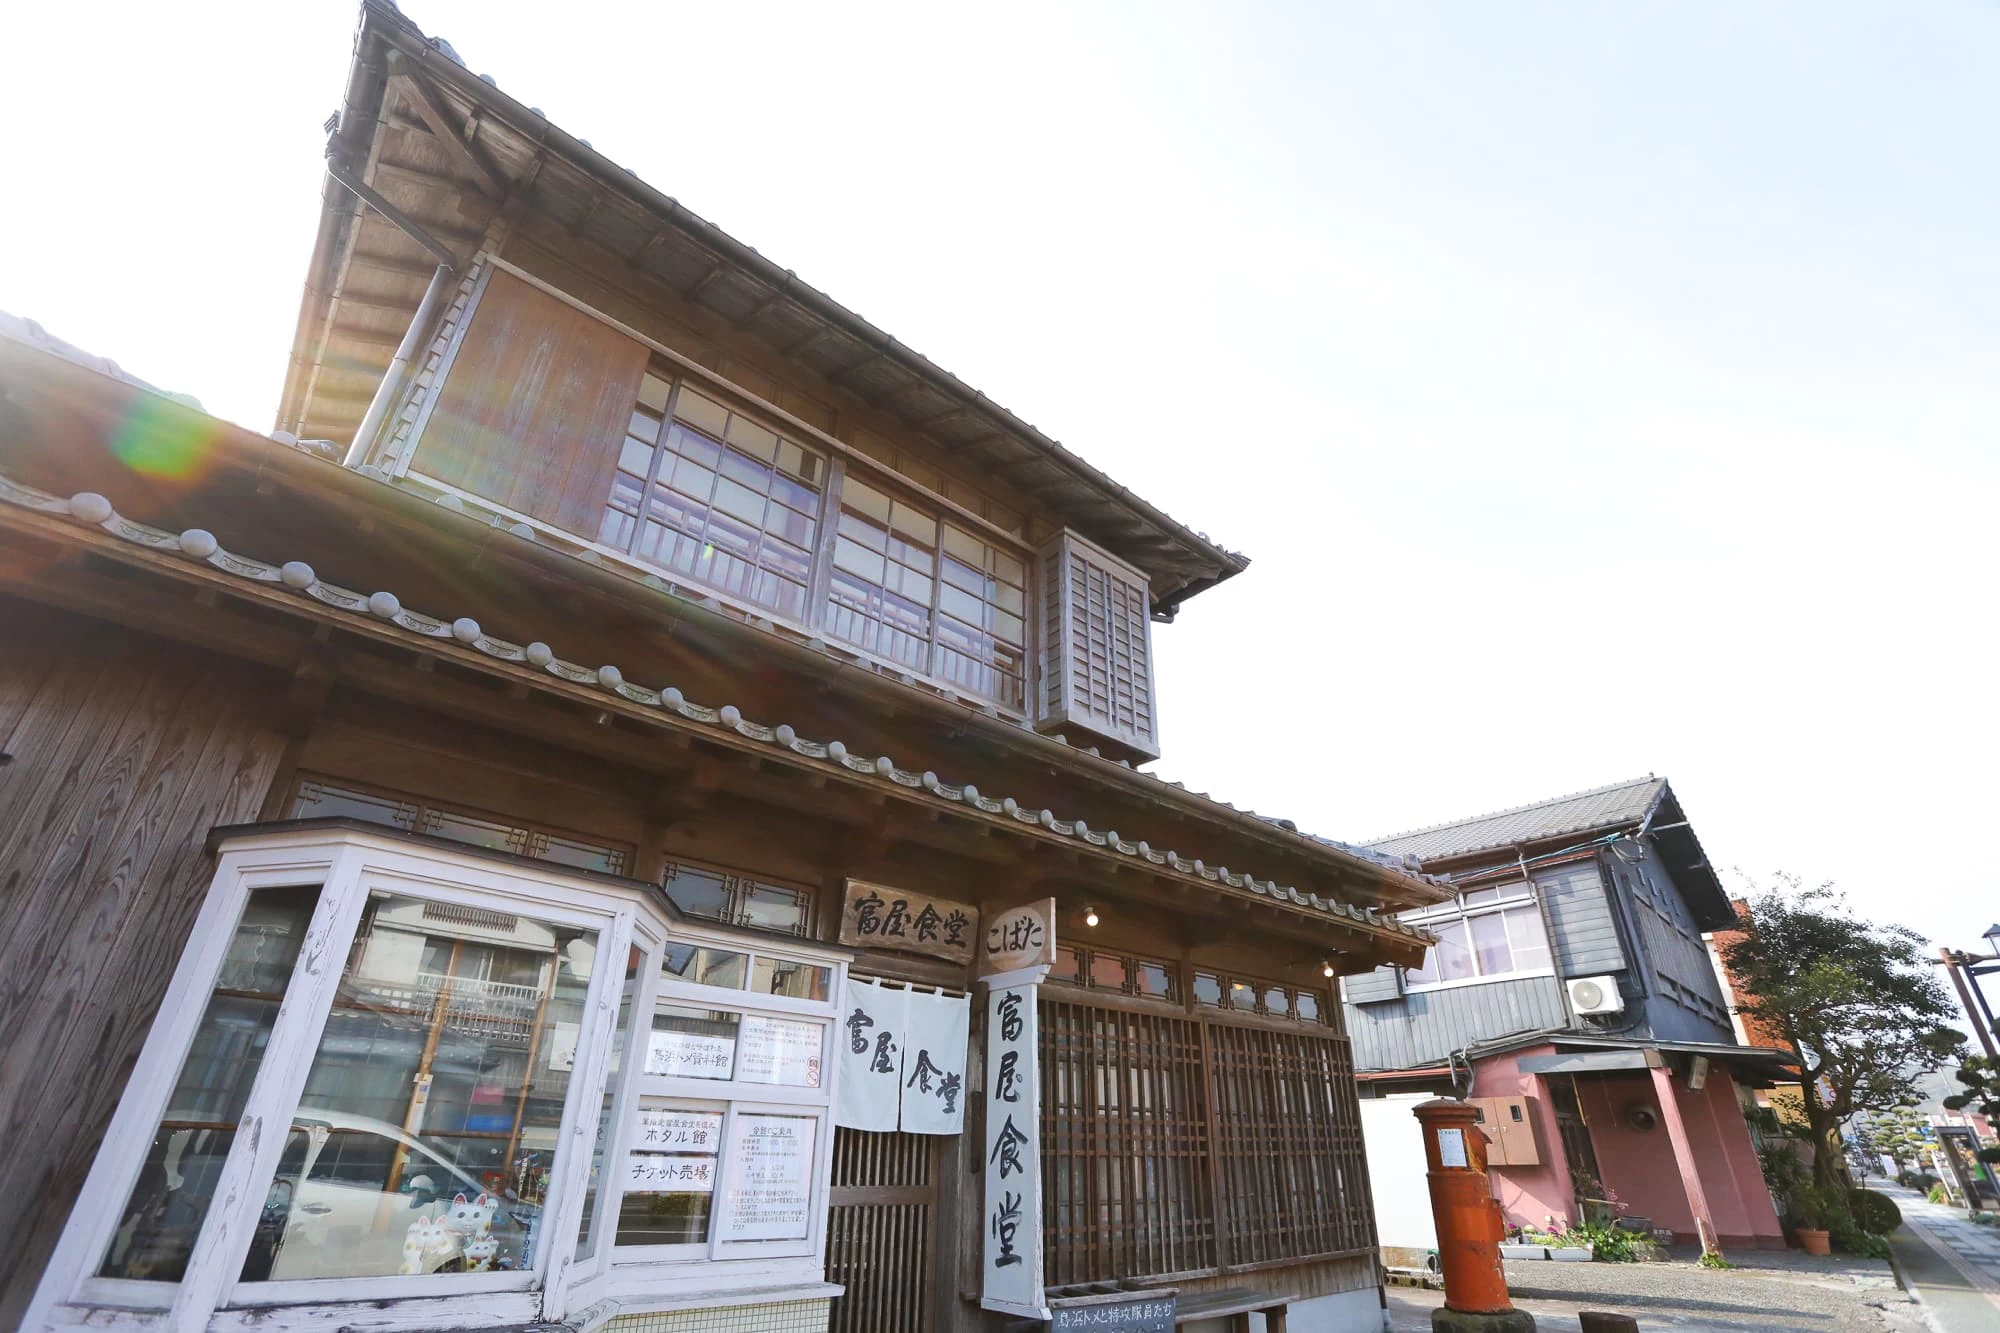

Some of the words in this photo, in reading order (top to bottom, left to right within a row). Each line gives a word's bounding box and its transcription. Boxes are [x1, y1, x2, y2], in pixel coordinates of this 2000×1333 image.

[854, 891, 969, 948] 富屋食堂
[846, 1008, 961, 1114] 富屋食堂
[645, 1127, 708, 1145] ホタル館
[990, 991, 1029, 1269] 富屋食堂
[631, 1164, 710, 1181] チケット売場
[1057, 1301, 1172, 1329] 鳥浜トメと特攻隊員たち
